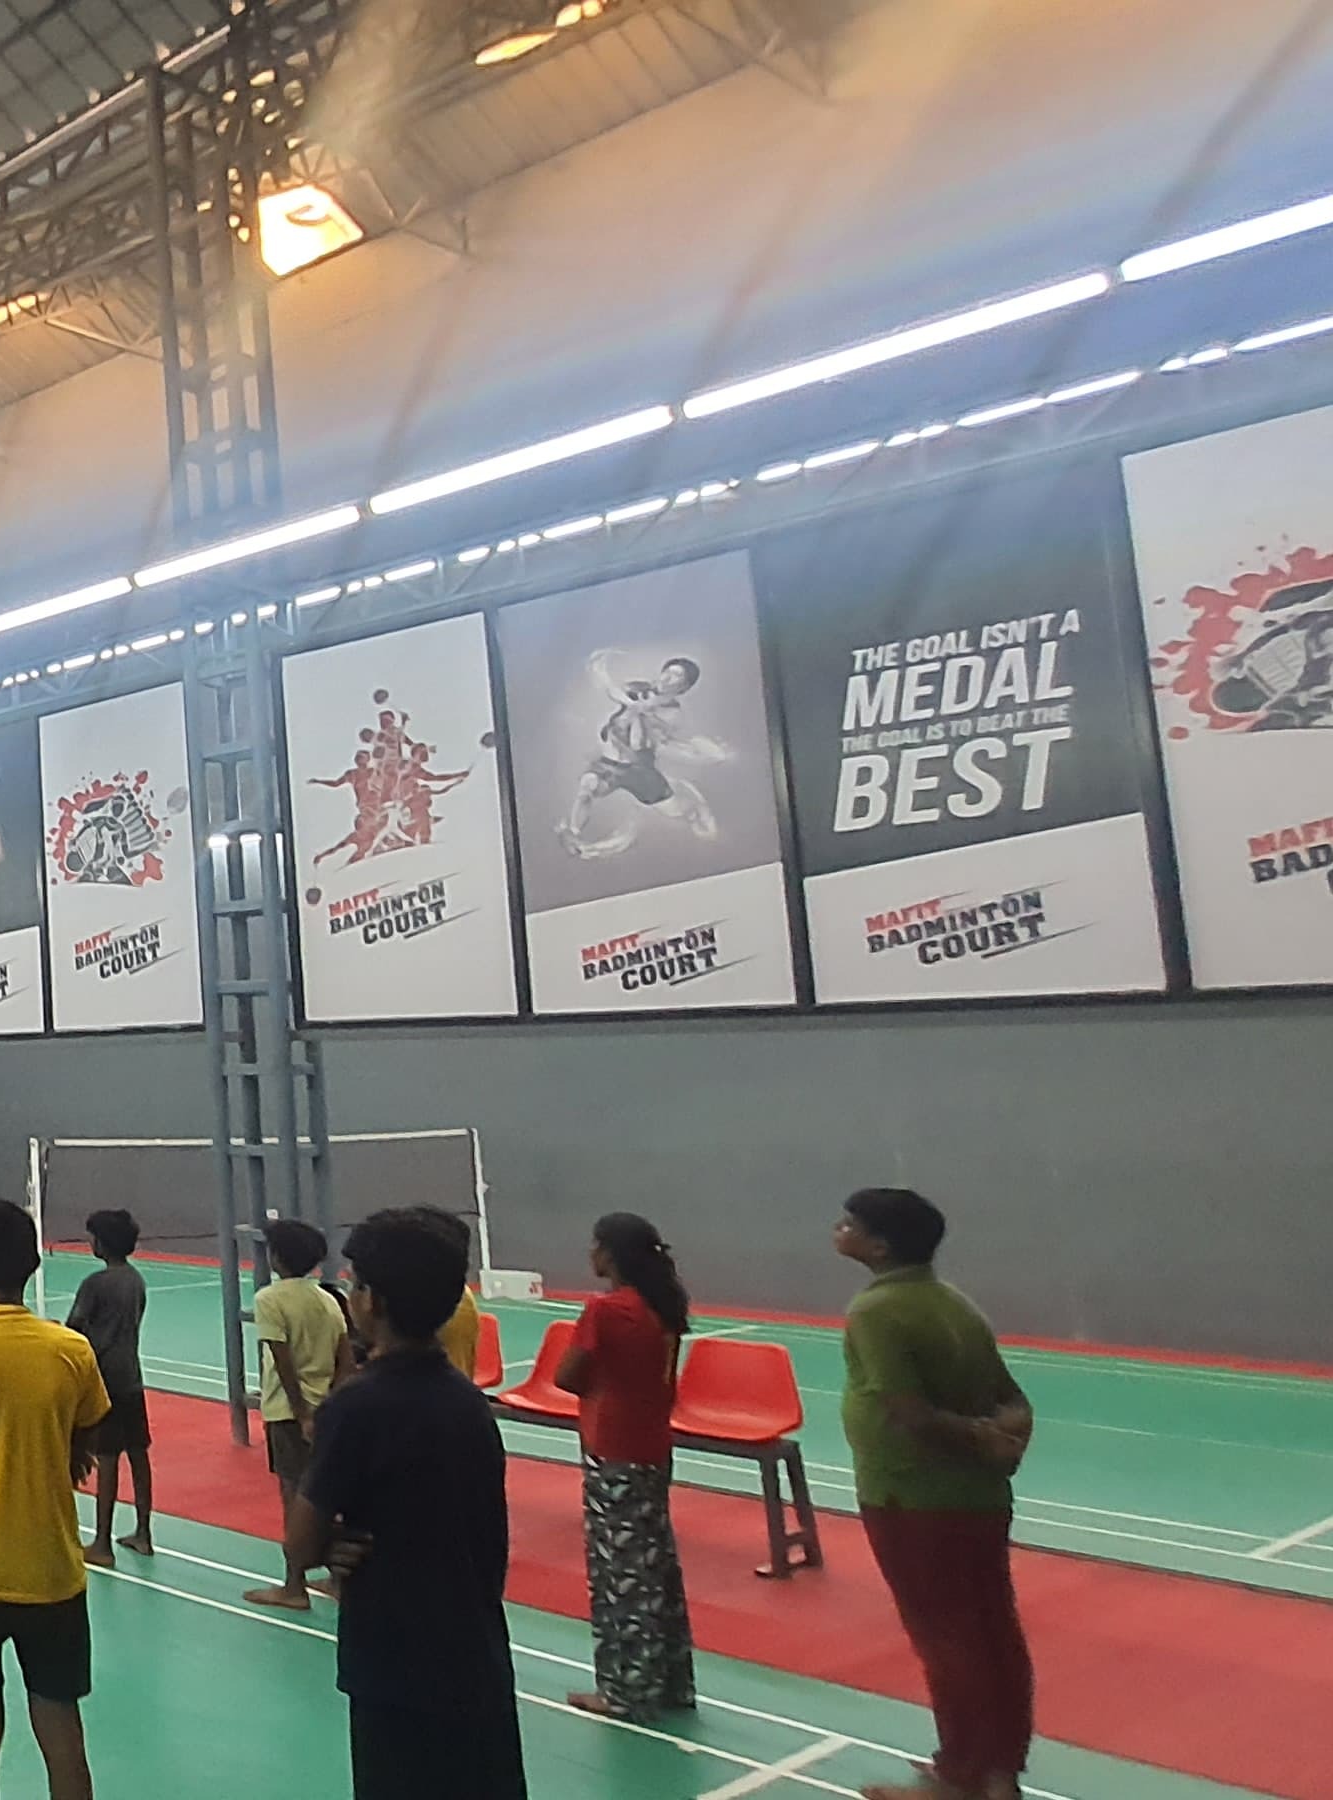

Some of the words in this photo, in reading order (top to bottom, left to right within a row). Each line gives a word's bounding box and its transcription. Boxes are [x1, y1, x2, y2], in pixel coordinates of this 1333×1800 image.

[852, 642, 901, 672] THE
[906, 630, 974, 663] GOAL
[980, 613, 1056, 649] ISN'T
[1059, 609, 1080, 636] A
[843, 641, 1074, 730] MEDAL
[842, 736, 873, 753] THE
[877, 727, 922, 748] GOAL
[925, 722, 945, 741] IS
[950, 719, 972, 737] TO
[976, 710, 1026, 733] BEAT
[1030, 704, 1071, 725] THE
[833, 726, 1073, 832] BEST
[329, 888, 379, 917] MAFIT
[329, 880, 446, 934] BADMINTON
[362, 900, 446, 945] COURT
[865, 899, 941, 933] MAFIT
[867, 891, 1042, 953] BADMINTON
[75, 924, 159, 970] BADMINTON
[99, 941, 161, 979] COURT
[581, 933, 640, 961] MAFIT
[582, 927, 717, 980] BADMINTON
[917, 912, 1045, 965] COURT
[621, 947, 717, 990] COURT
